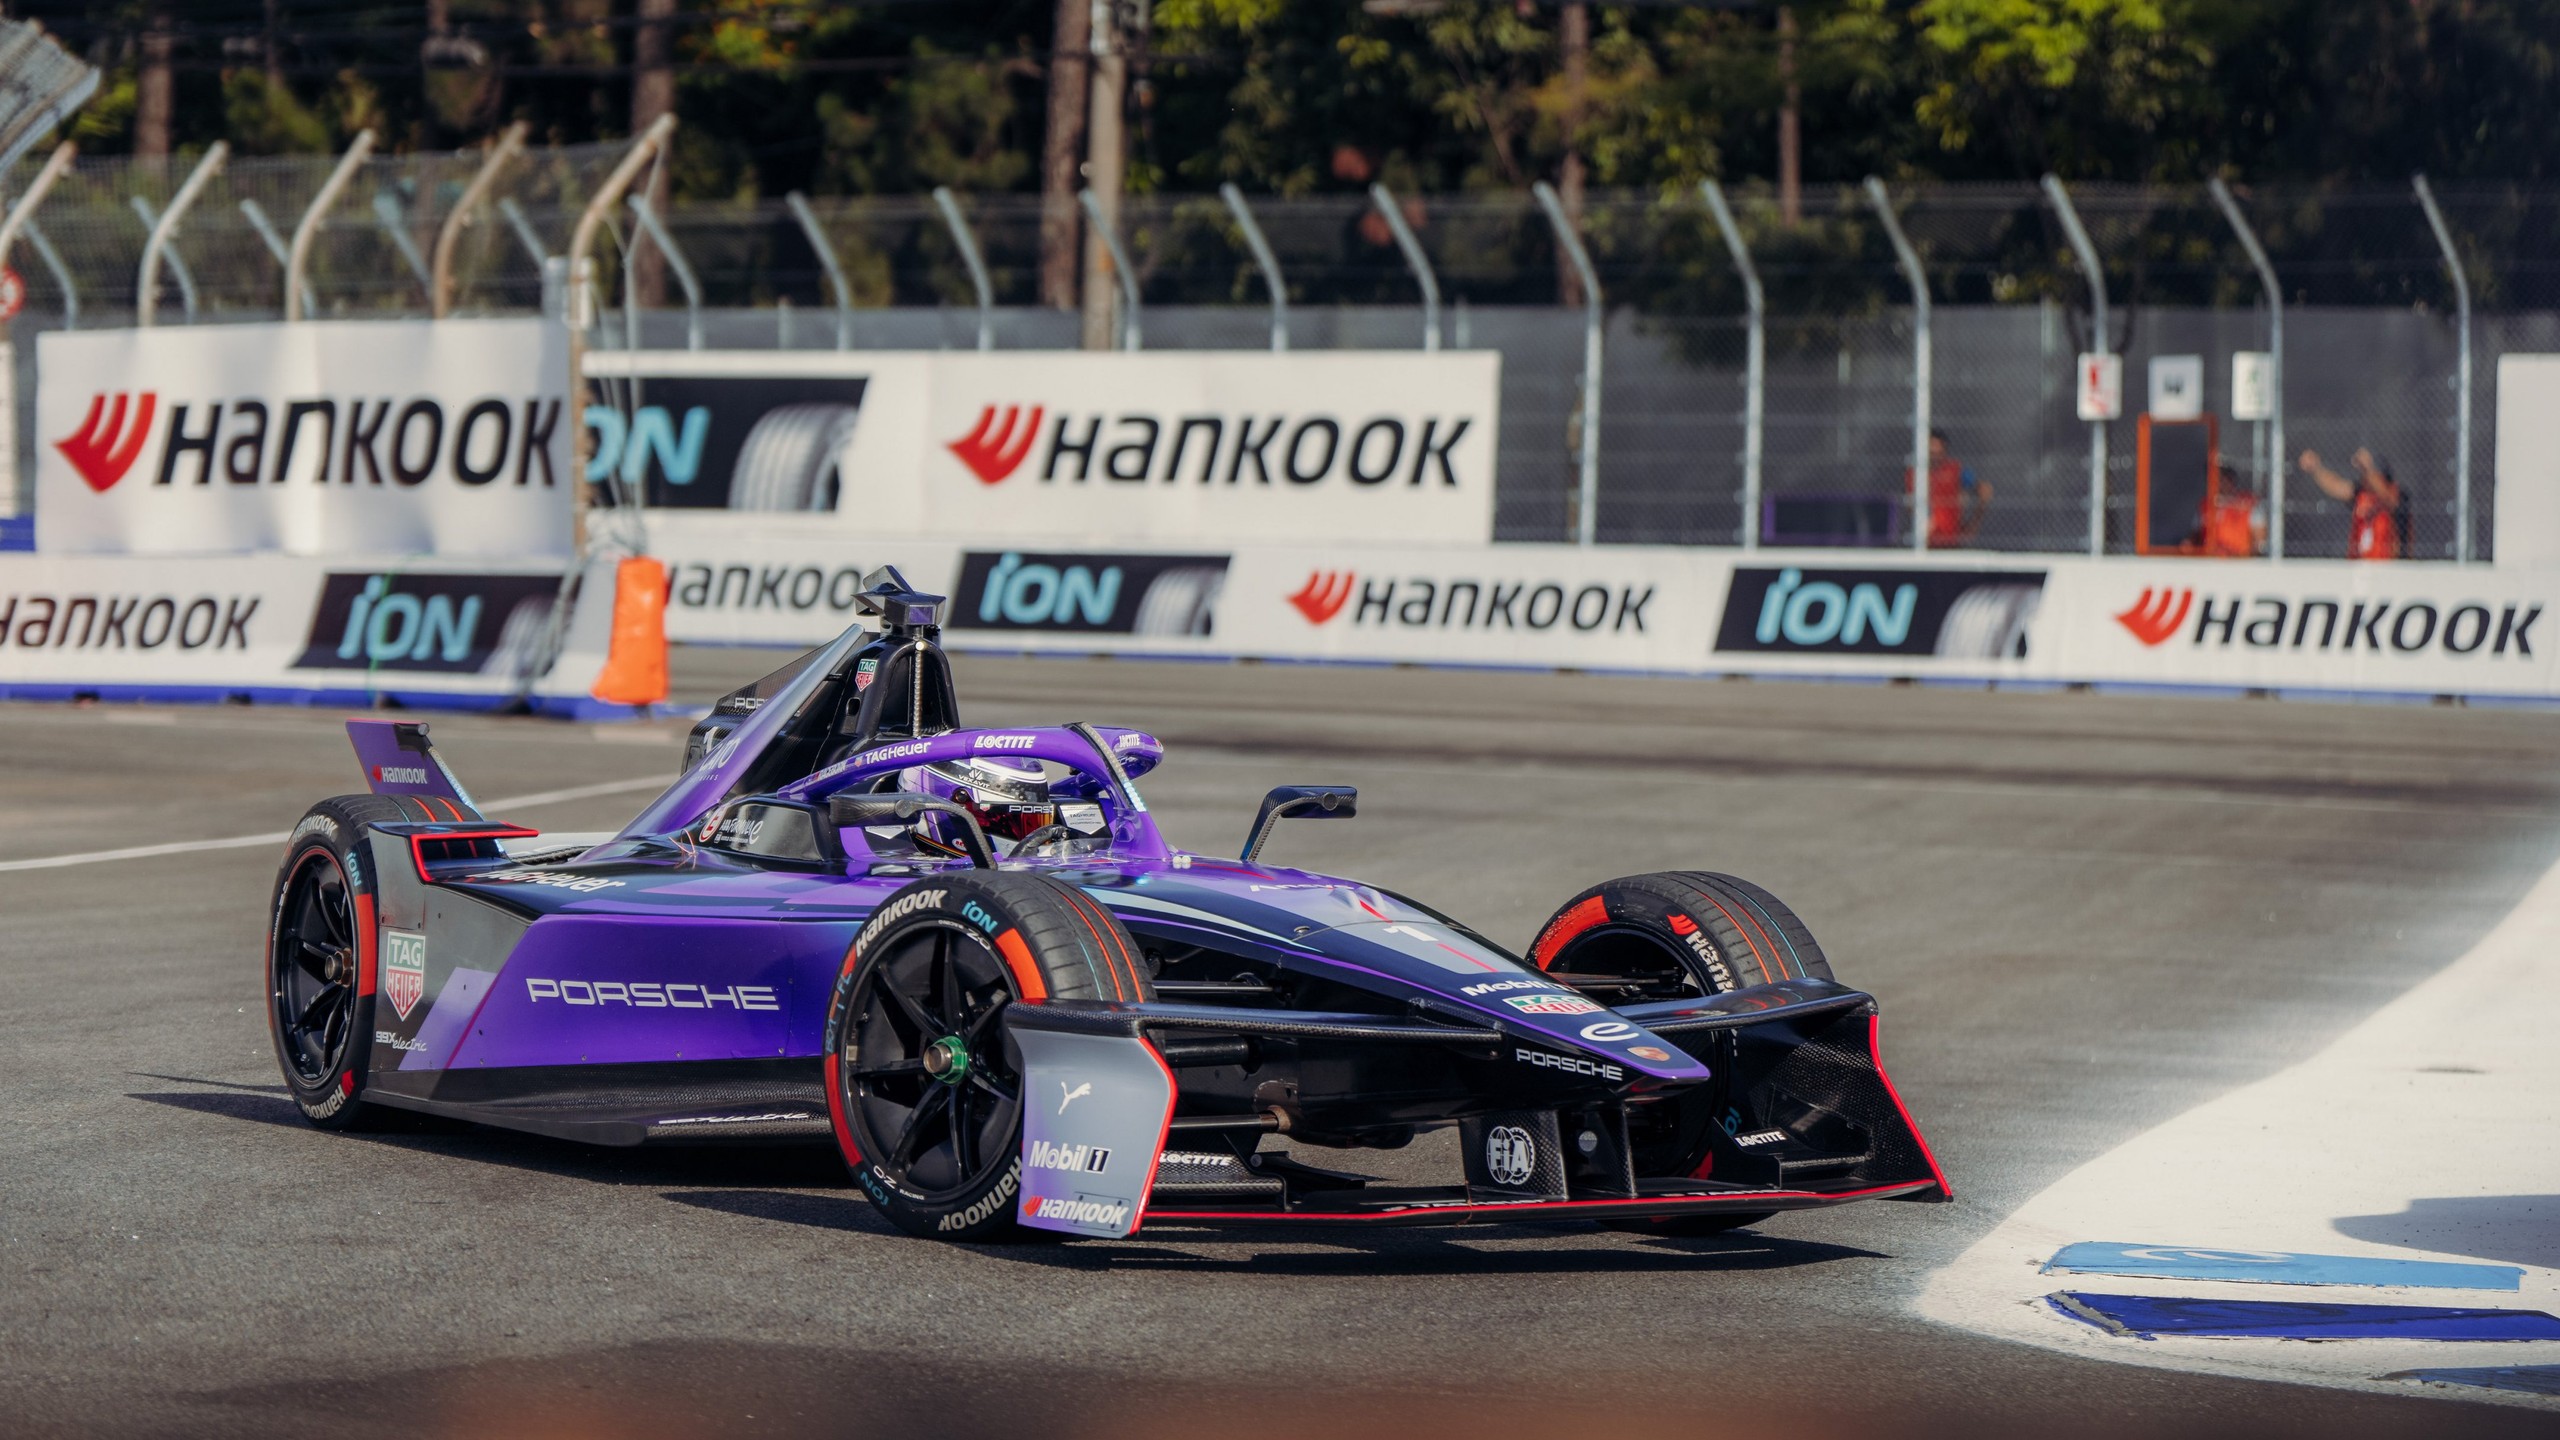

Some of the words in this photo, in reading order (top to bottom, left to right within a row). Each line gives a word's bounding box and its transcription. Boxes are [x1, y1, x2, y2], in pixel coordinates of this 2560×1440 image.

[583, 404, 709, 485] ON
[860, 661, 875, 672] TAG
[974, 736, 1037, 749] LOCTITE
[959, 774, 990, 789] VEXAVIT
[391, 938, 422, 967] TAG
[387, 972, 421, 1014] HEUER
[526, 978, 780, 1011] PORSCHE
[1515, 1048, 1623, 1081] PORSCHE
[1734, 1130, 1788, 1148] LOCTITE
[1029, 1140, 1088, 1173] Mobil
[1158, 1153, 1233, 1166] LOCTITE
